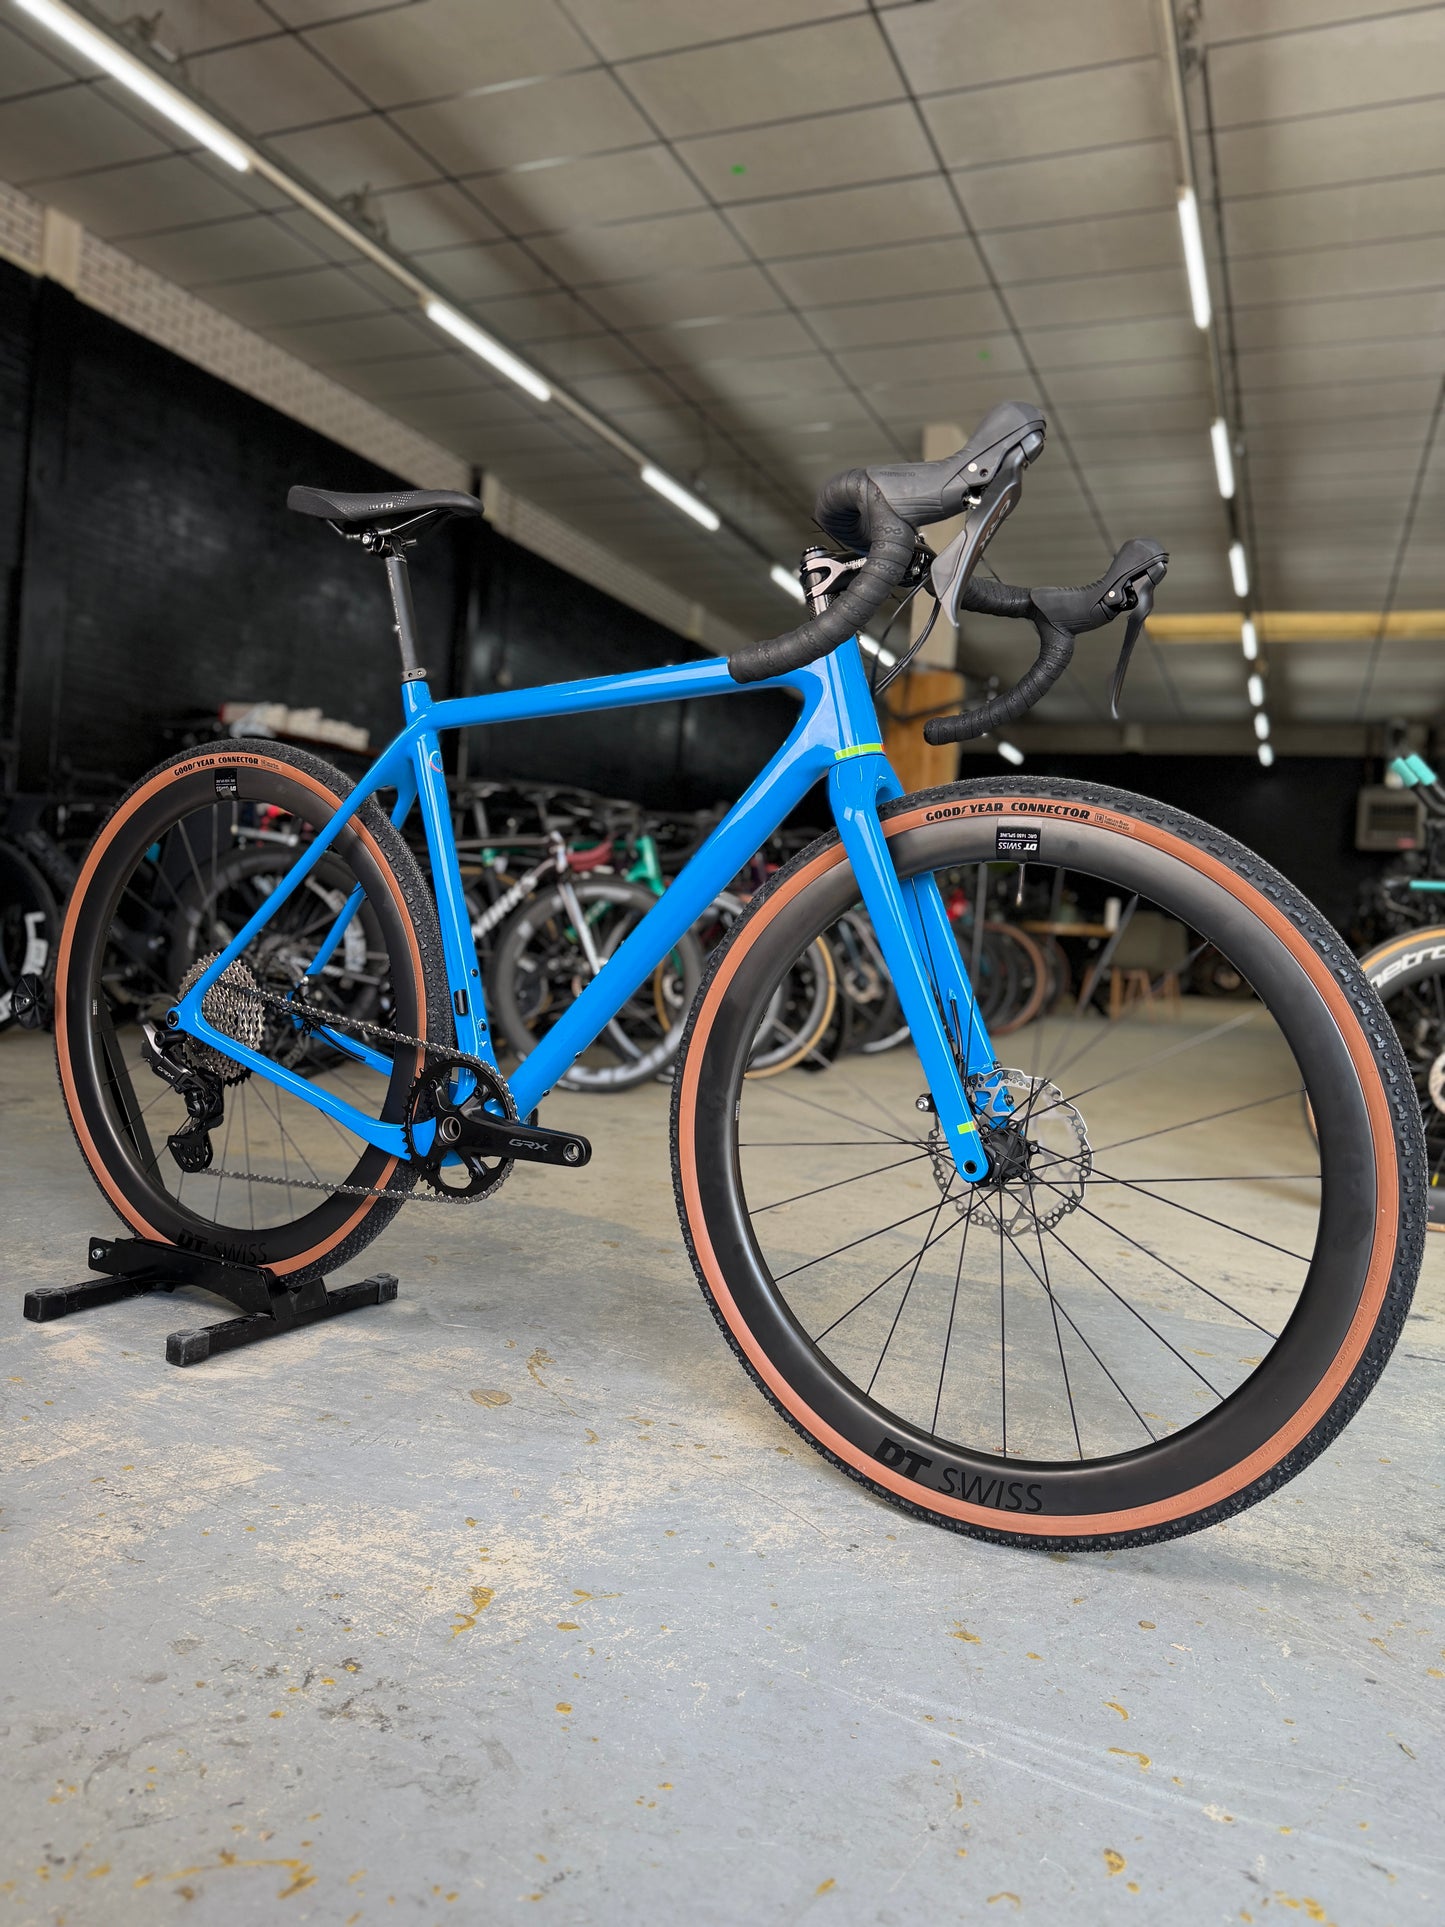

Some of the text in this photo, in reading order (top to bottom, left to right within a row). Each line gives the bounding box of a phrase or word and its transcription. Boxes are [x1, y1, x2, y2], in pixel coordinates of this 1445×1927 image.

[174, 758, 215, 776] GOODYEAR
[218, 756, 259, 765] CONNECTOR
[925, 802, 1091, 821] GOODYEAR CONNECTOR
[998, 842, 1038, 851] DT SWISS
[508, 1138, 549, 1152] GRX
[214, 1241, 267, 1263] SWISS
[873, 1437, 1043, 1512] DT SWISS
